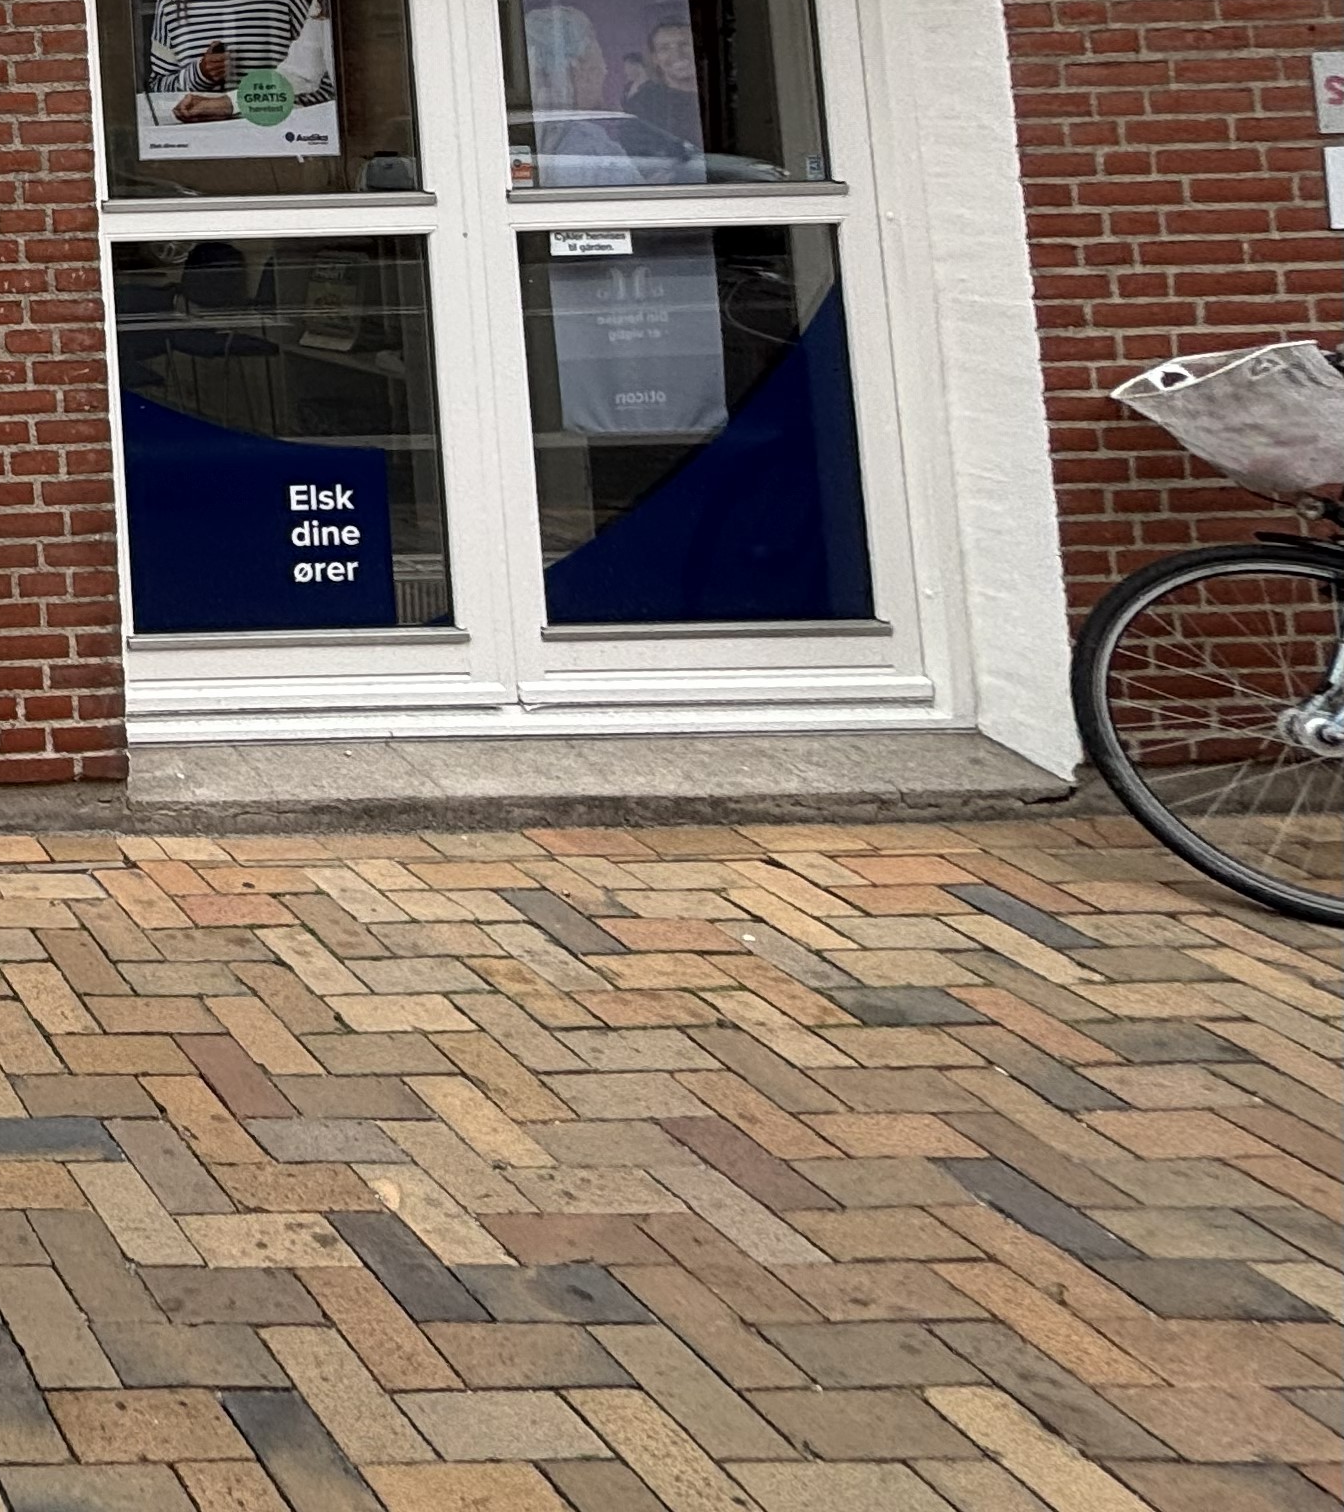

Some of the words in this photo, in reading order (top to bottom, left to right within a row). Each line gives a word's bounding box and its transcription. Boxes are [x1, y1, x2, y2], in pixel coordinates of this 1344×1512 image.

[244, 92, 287, 103] GRATIS
[289, 483, 355, 511] Elsk
[291, 519, 361, 547] dine
[293, 561, 359, 583] ører
